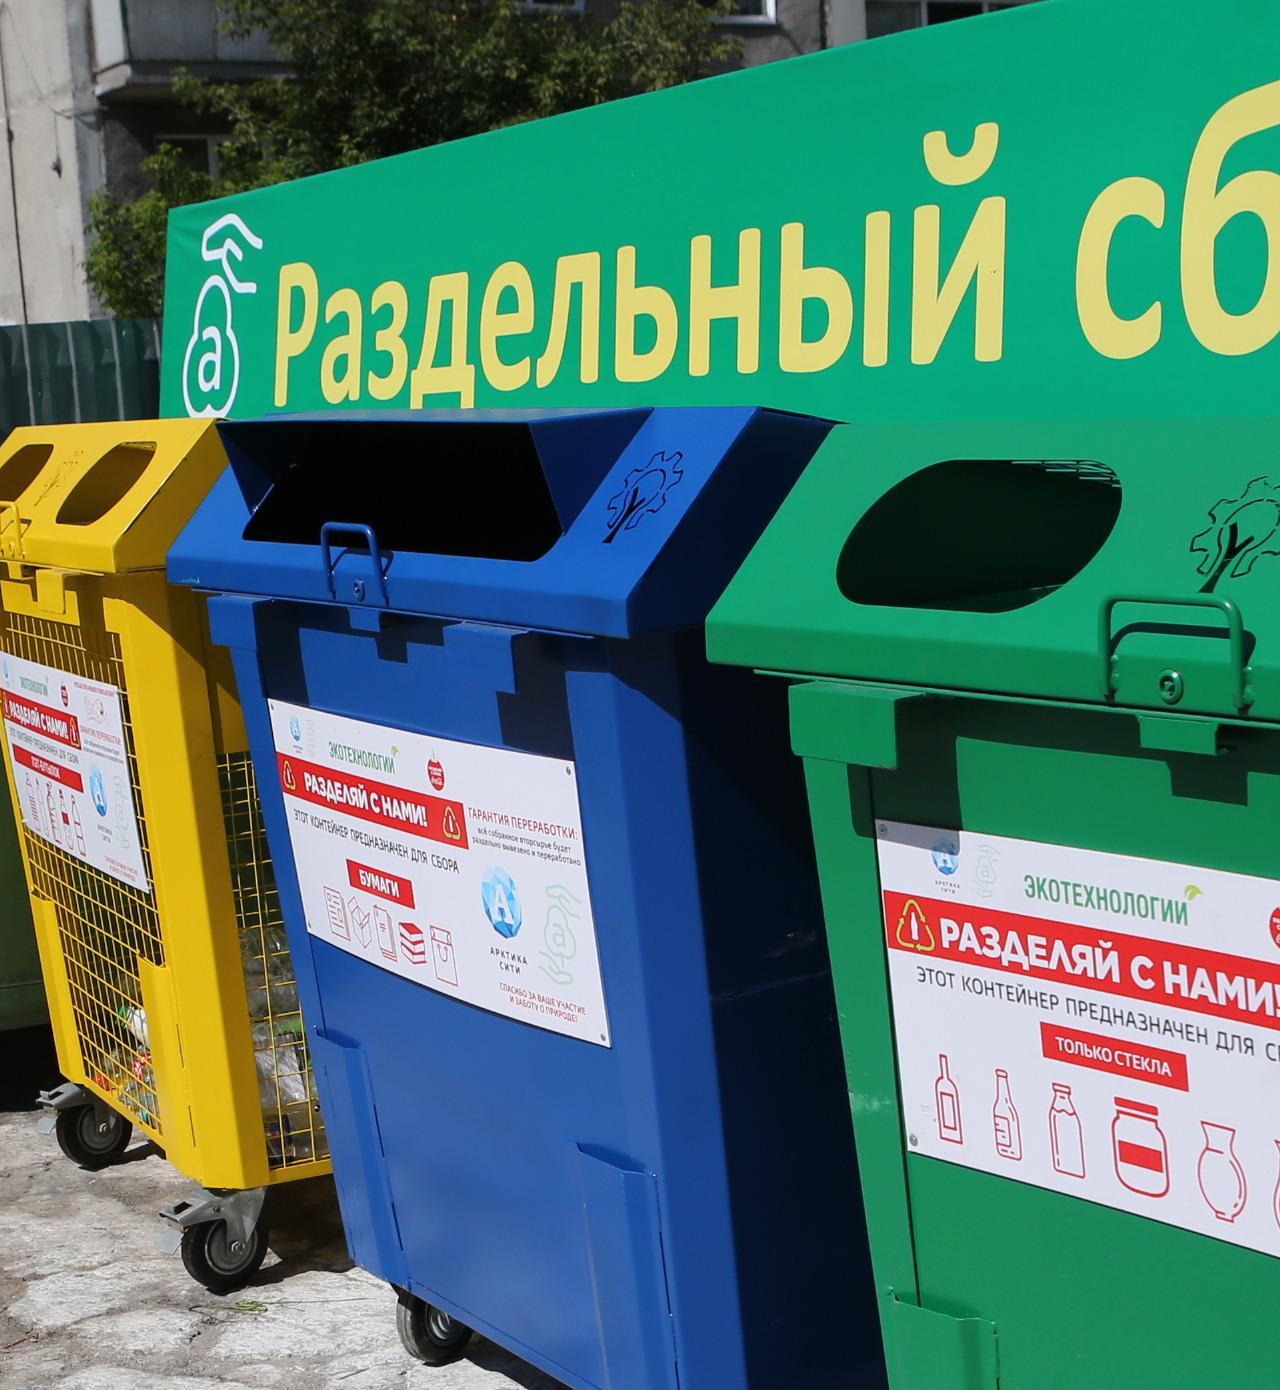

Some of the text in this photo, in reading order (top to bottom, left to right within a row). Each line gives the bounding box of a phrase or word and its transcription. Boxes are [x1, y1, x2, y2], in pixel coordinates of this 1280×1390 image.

[274, 121, 1006, 409] Раздельный
[328, 741, 396, 774] ЭКОТЕХНОЛОГИИ
[304, 771, 429, 828] РАЗДЕЛЯЙ С НАМИ!
[468, 807, 578, 840] ГАРАНТИЯ ПЕРЕРАБОТКИ:
[293, 808, 459, 874] ЭТОТ КОНТЕЙНЕР ПРЕДНАЗНАЧЕН ДЛЯ СБОРА
[552, 841, 571, 854] будет
[358, 869, 400, 898] БУМАГИ
[1024, 874, 1189, 927] ЭКОТЕХНОЛОГИИ
[490, 947, 528, 965] АРКТИКА
[499, 961, 521, 975] СИТИ
[940, 917, 1121, 984] РАЗДЕЛЯЙ
[1130, 955, 1157, 990] С
[499, 982, 586, 1016] СПАСИБО ЗА ВАШЕ УЧАСТИЕ
[514, 997, 539, 1012] ЗАБОТУ
[916, 966, 955, 989] ЭТОТ
[961, 975, 1059, 1011] КОНТЕЙНЕР
[1066, 997, 1208, 1045] ПРЕДНАЗНАЧЕН
[1216, 1031, 1255, 1056] ДЛЯ
[1055, 1036, 1172, 1077] ТОЛЬКО СТЕКЛА
